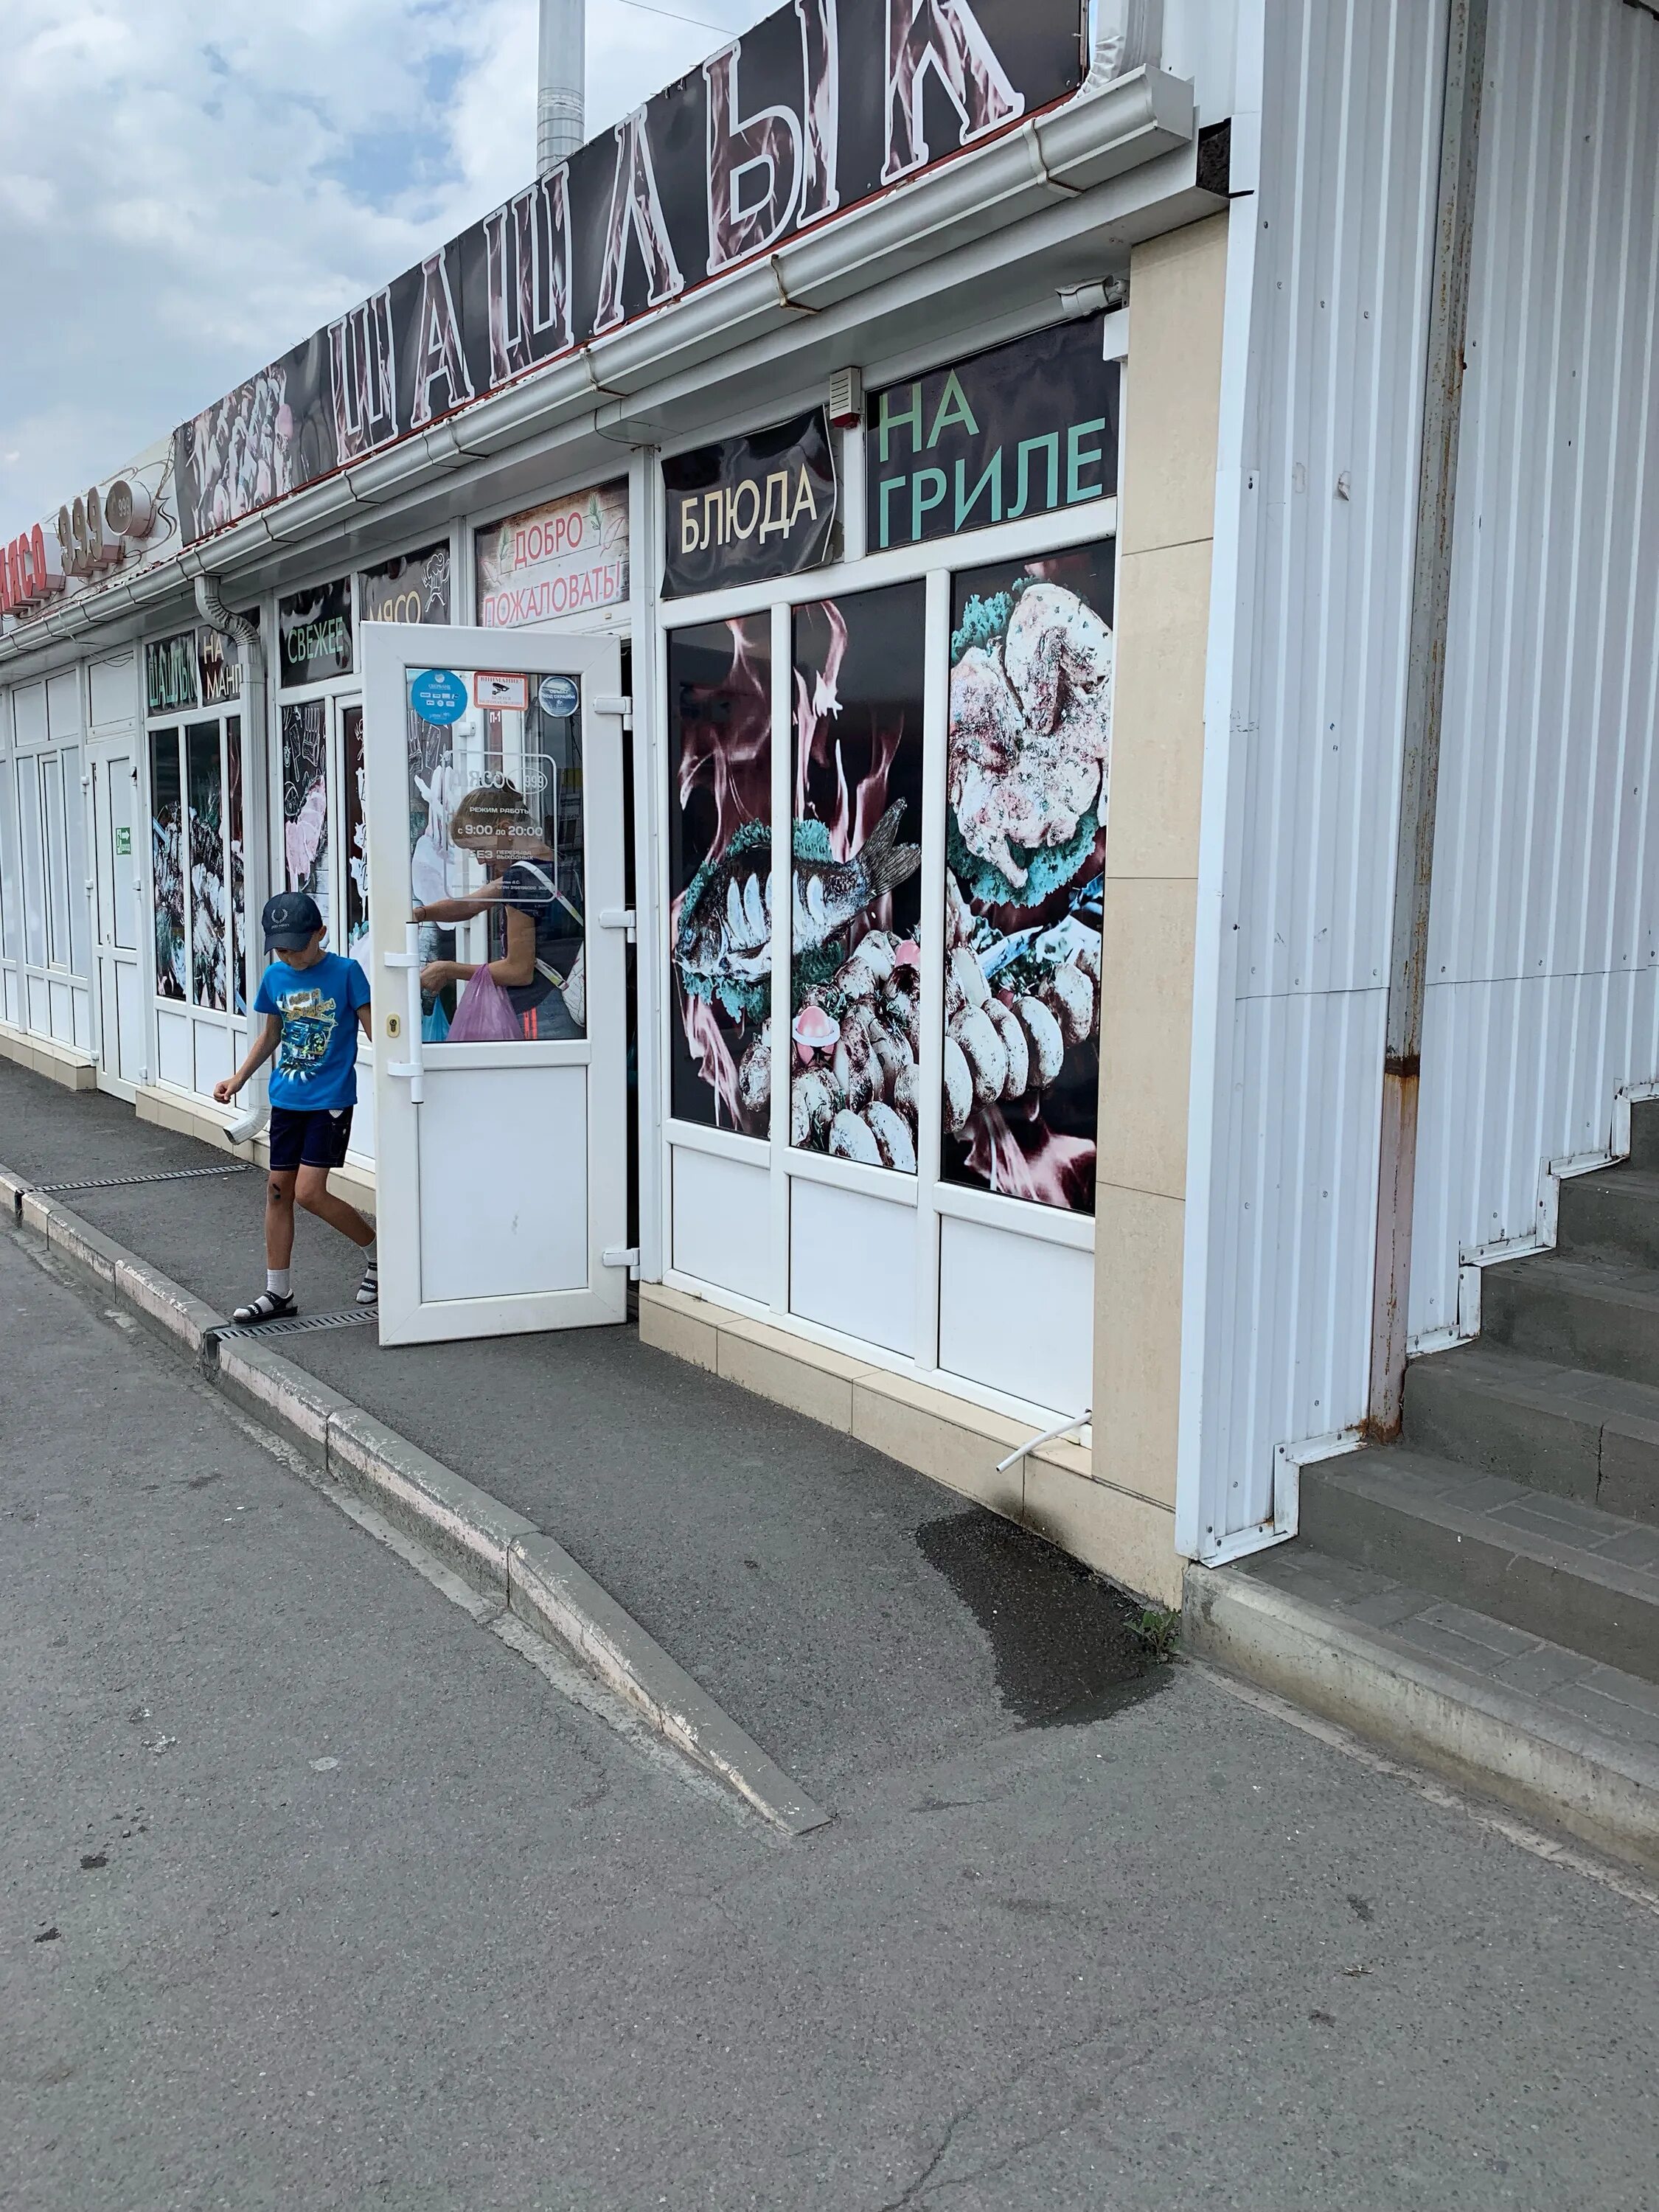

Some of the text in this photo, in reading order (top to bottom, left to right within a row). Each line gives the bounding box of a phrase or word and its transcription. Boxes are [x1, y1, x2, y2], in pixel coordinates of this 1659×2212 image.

[327, 0, 1025, 467] ШАШЛЫК
[879, 368, 980, 462] НА
[681, 463, 817, 554] БЛЮДА
[879, 417, 1106, 548] ГРИЛЕ
[58, 486, 104, 577] 999
[514, 512, 582, 571] ДОБРО
[484, 560, 620, 627] ПОЖАЛОВАТЬ!
[203, 633, 224, 664] НА
[288, 616, 344, 664] СВЕЖЕЕ
[525, 776, 543, 788] 999
[465, 824, 493, 835] 9:00
[508, 826, 543, 836] 20:00
[469, 849, 493, 859] БЕЗ
